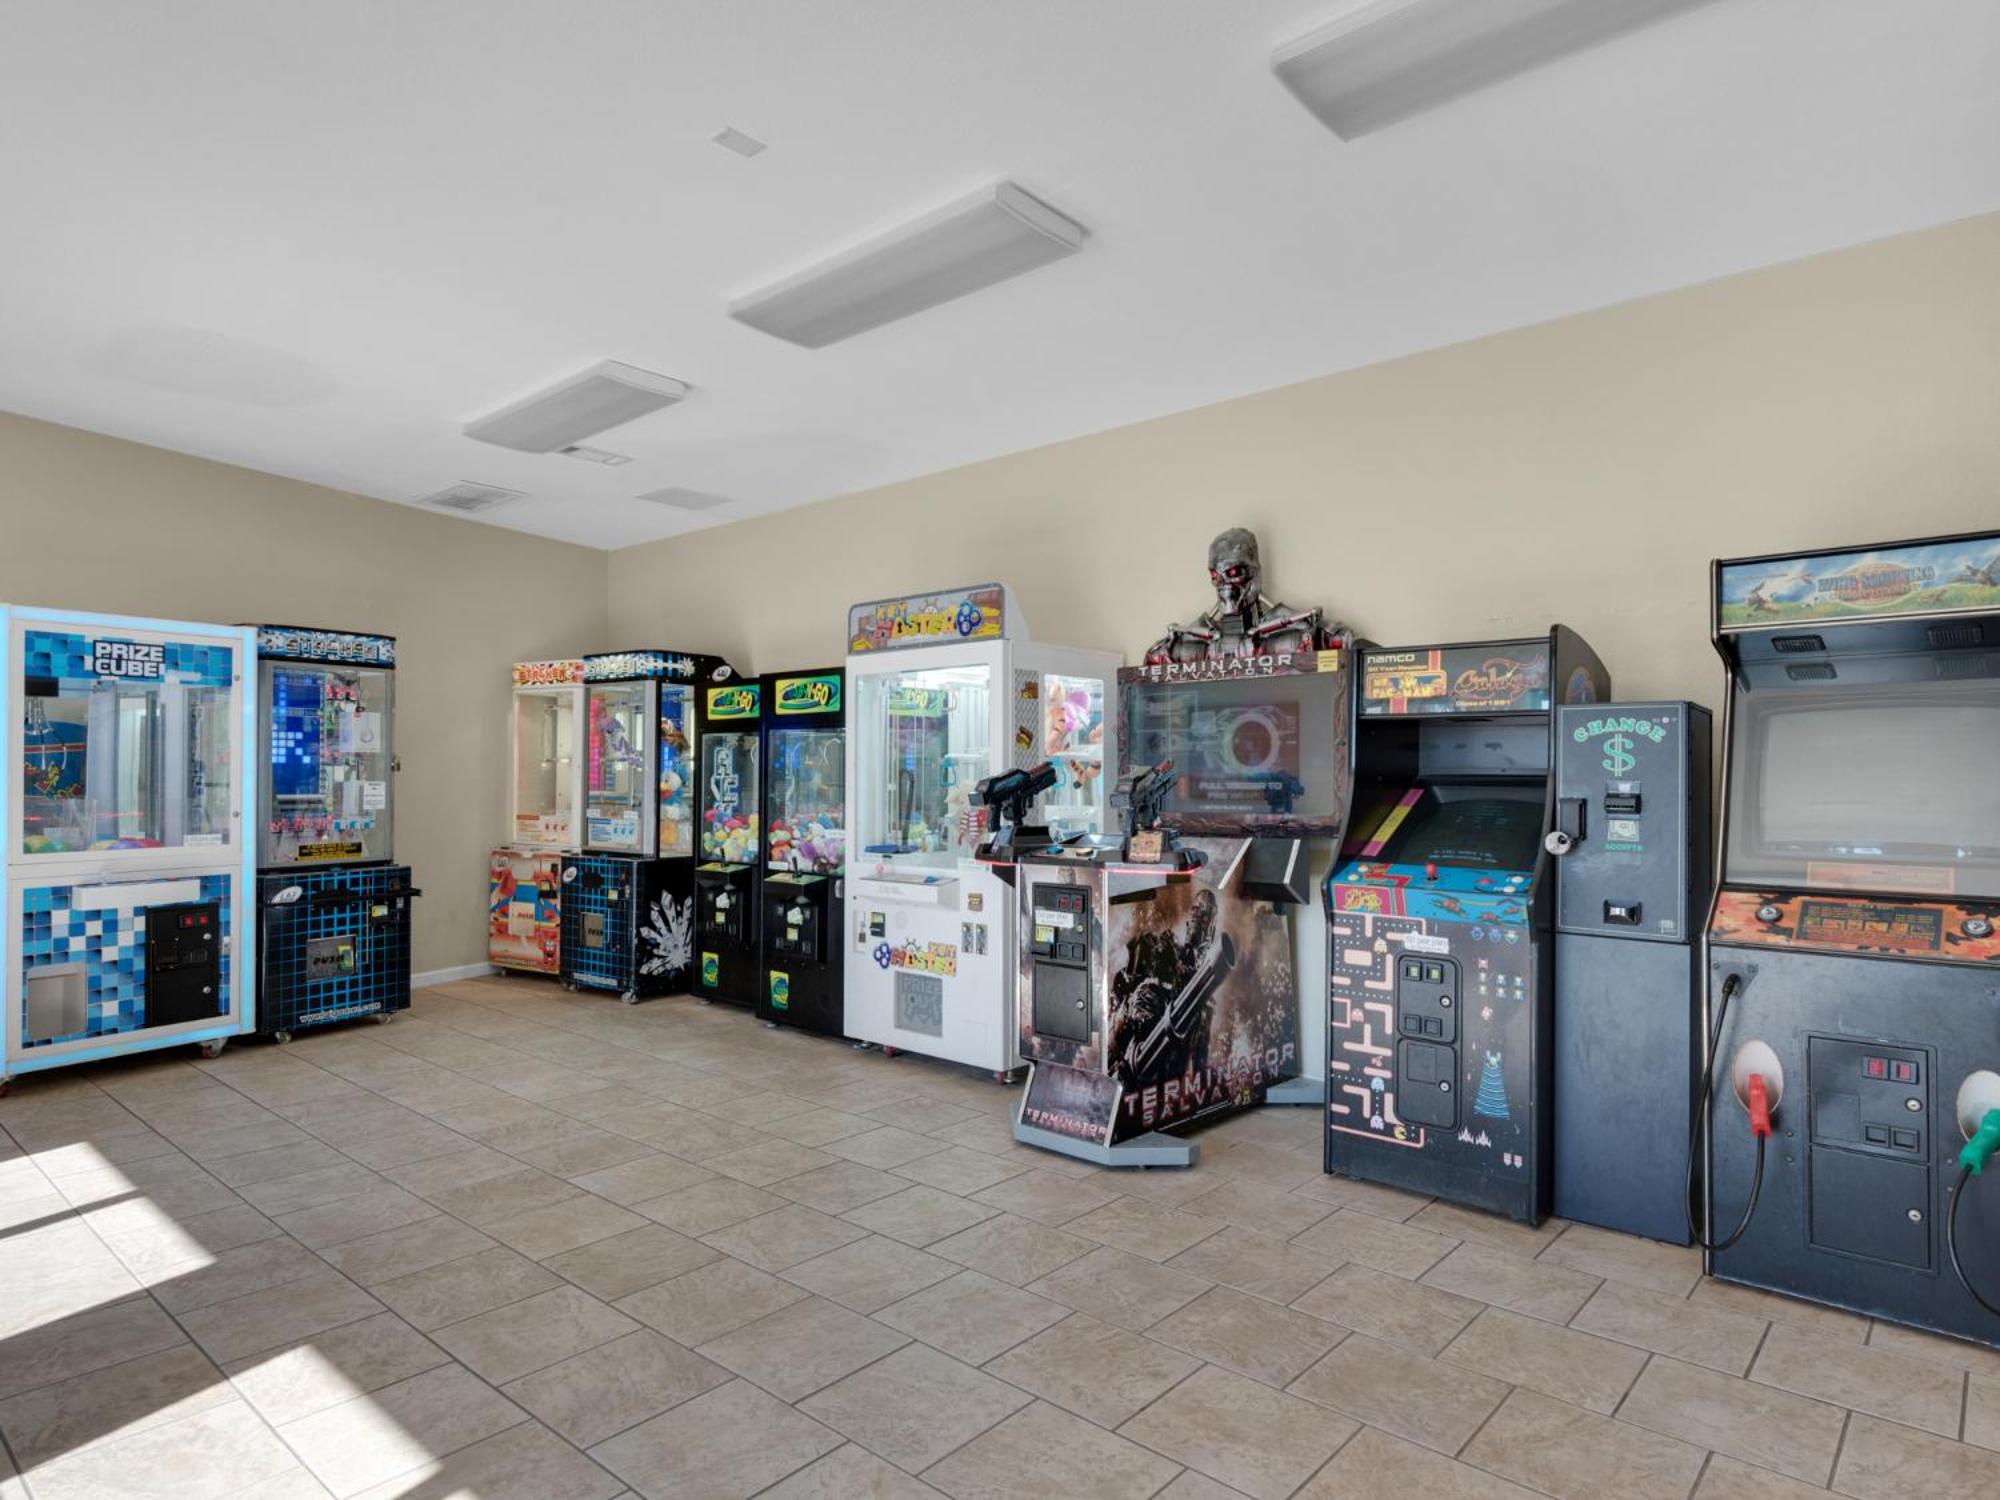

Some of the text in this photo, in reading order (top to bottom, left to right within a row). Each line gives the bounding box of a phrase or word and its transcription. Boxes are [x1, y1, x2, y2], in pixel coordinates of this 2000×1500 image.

[95, 642, 164, 662] PRIZE
[1367, 653, 1415, 664] namco
[95, 658, 159, 677] CUBE
[1138, 653, 1293, 677] TERMINATOR
[1151, 666, 1275, 684] SALVATION
[1573, 717, 1666, 743] CHANGE
[1602, 732, 1636, 777] $
[1123, 1043, 1296, 1117] TERMINATOR
[1142, 1064, 1282, 1126] SALVATION
